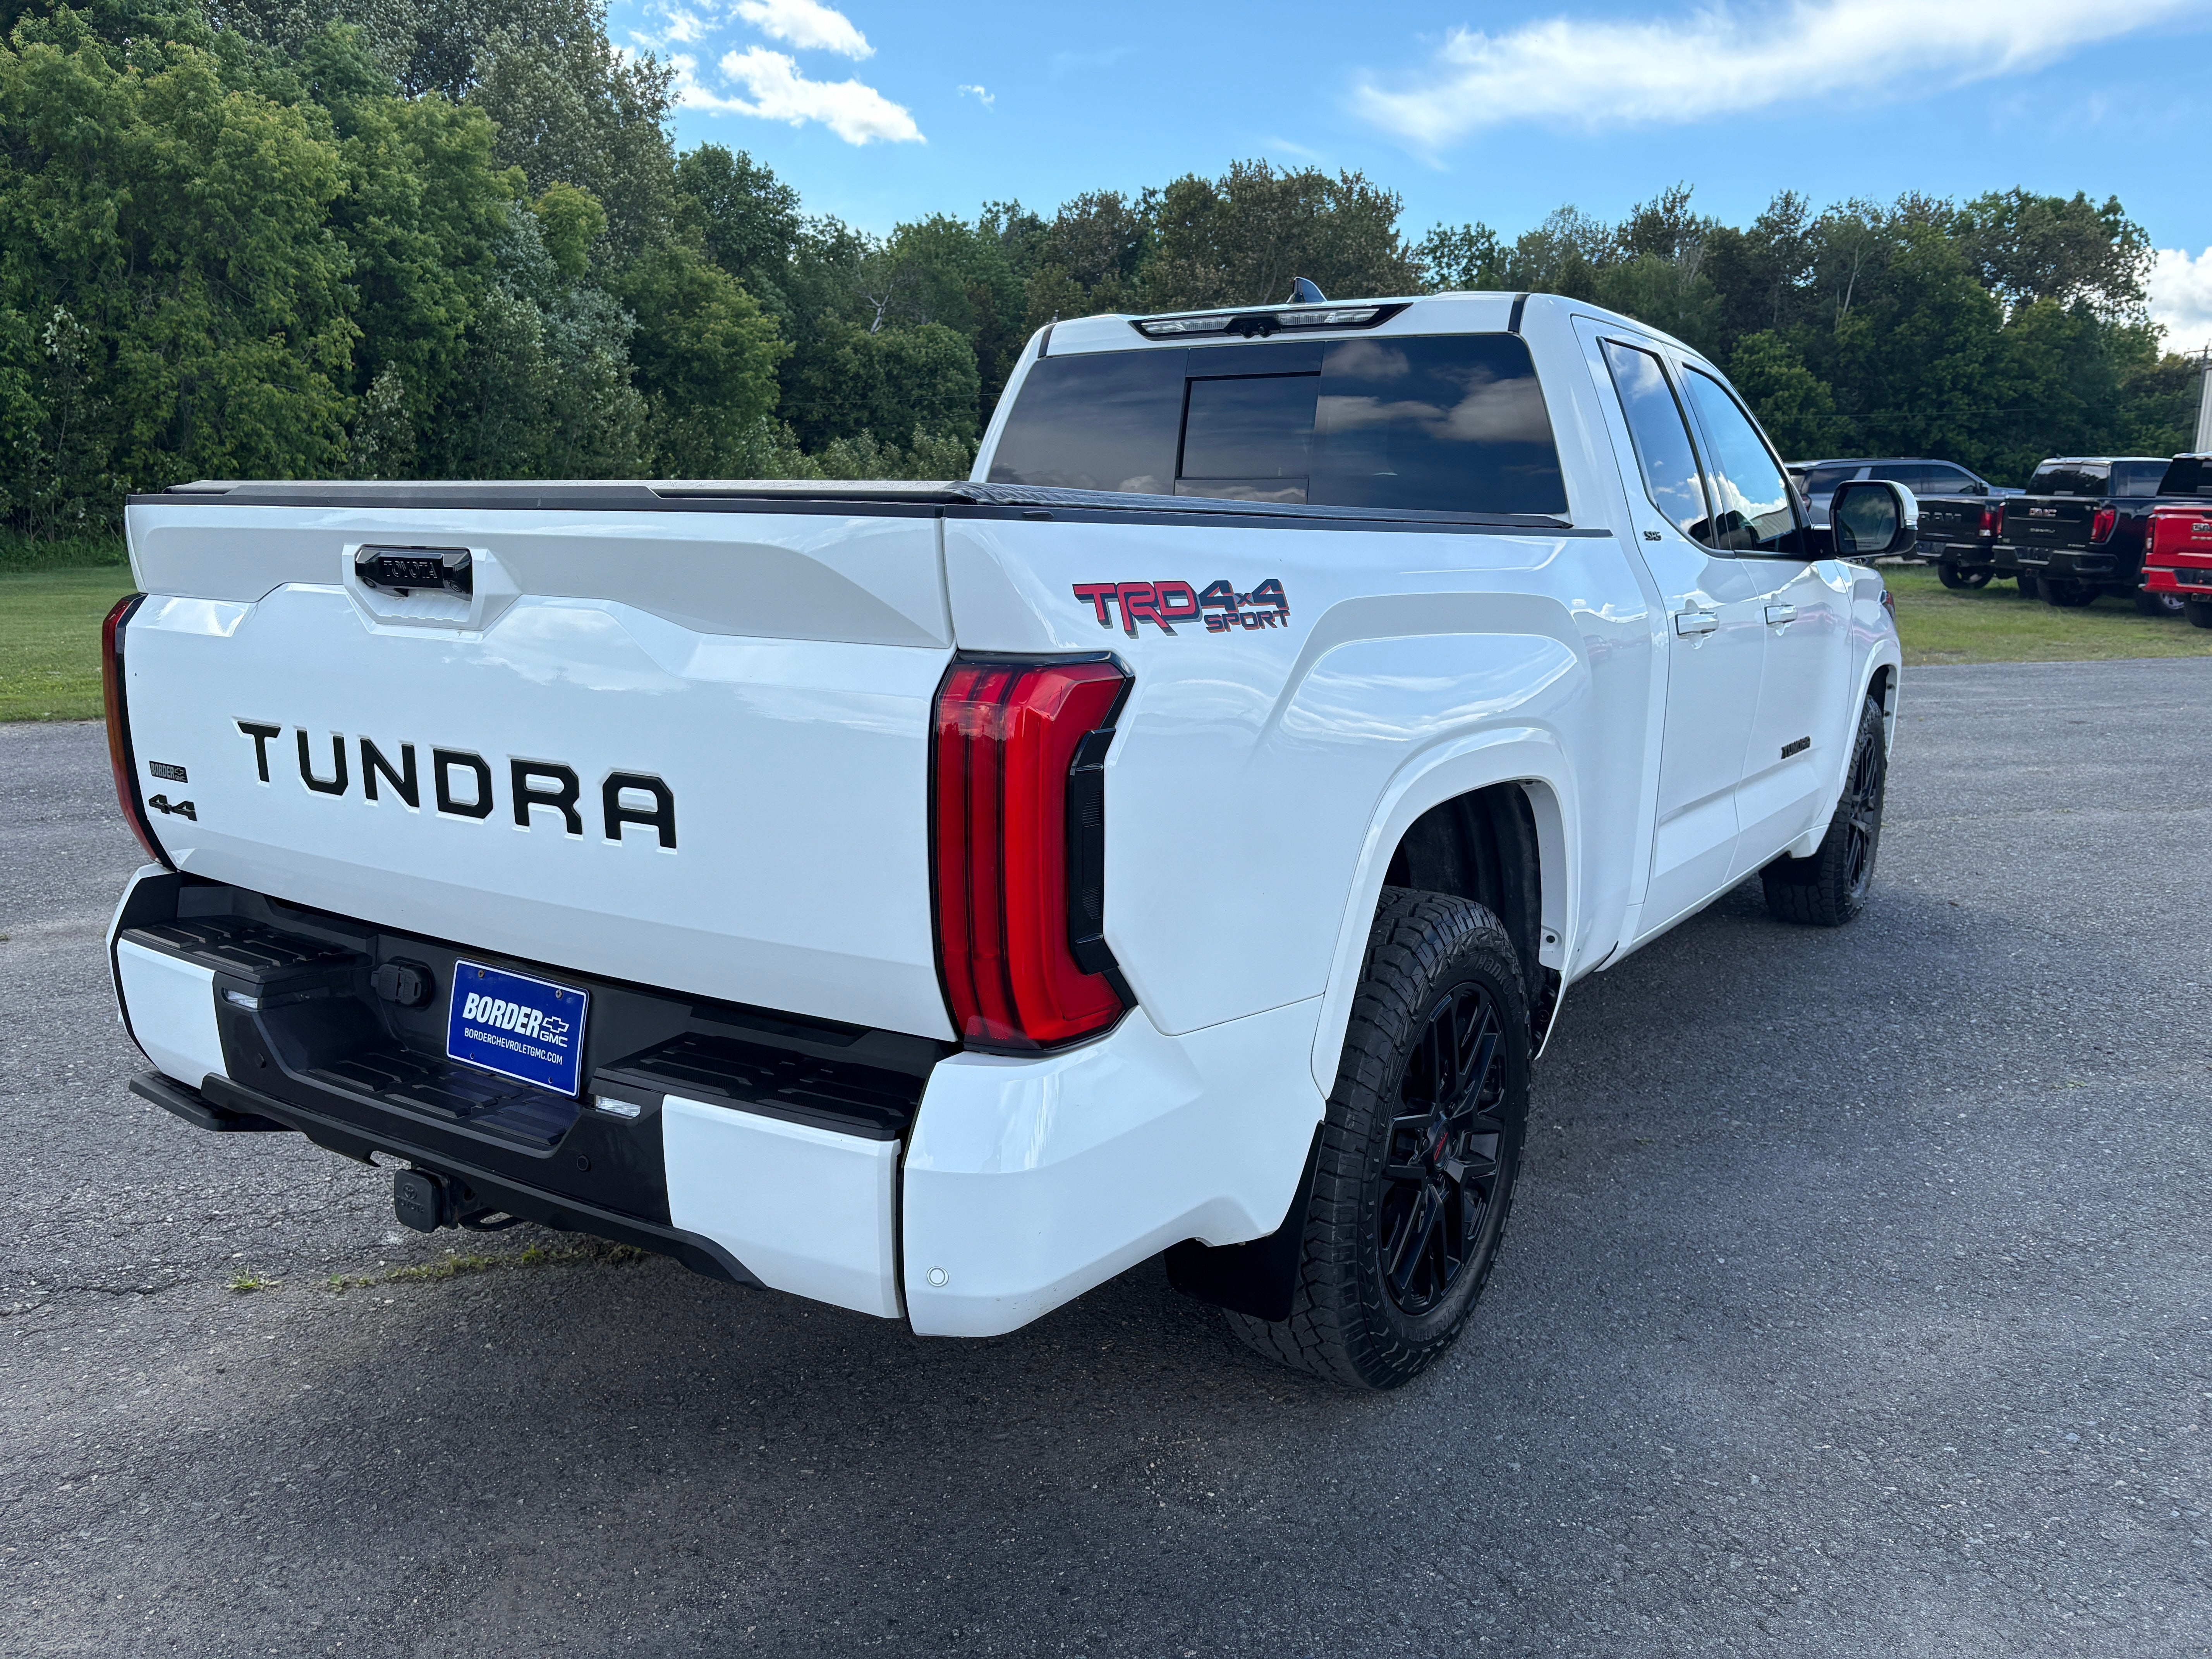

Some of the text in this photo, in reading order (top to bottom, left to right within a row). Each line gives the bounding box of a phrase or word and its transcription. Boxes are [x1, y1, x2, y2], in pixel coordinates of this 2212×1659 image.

[1643, 531, 1662, 541] SR5
[2192, 523, 2212, 532] GM
[383, 560, 438, 579] TOYOTA
[1072, 580, 1203, 639] TRD
[1204, 610, 1291, 634] SPORT
[1781, 736, 1810, 759] TUNDRA
[150, 763, 175, 779] BORDER
[235, 719, 678, 851] TUNDRA
[462, 992, 543, 1038] BORDER
[464, 1027, 563, 1065] BORDERCHEVROLETGMC.COM
[540, 1030, 568, 1048] GMC
